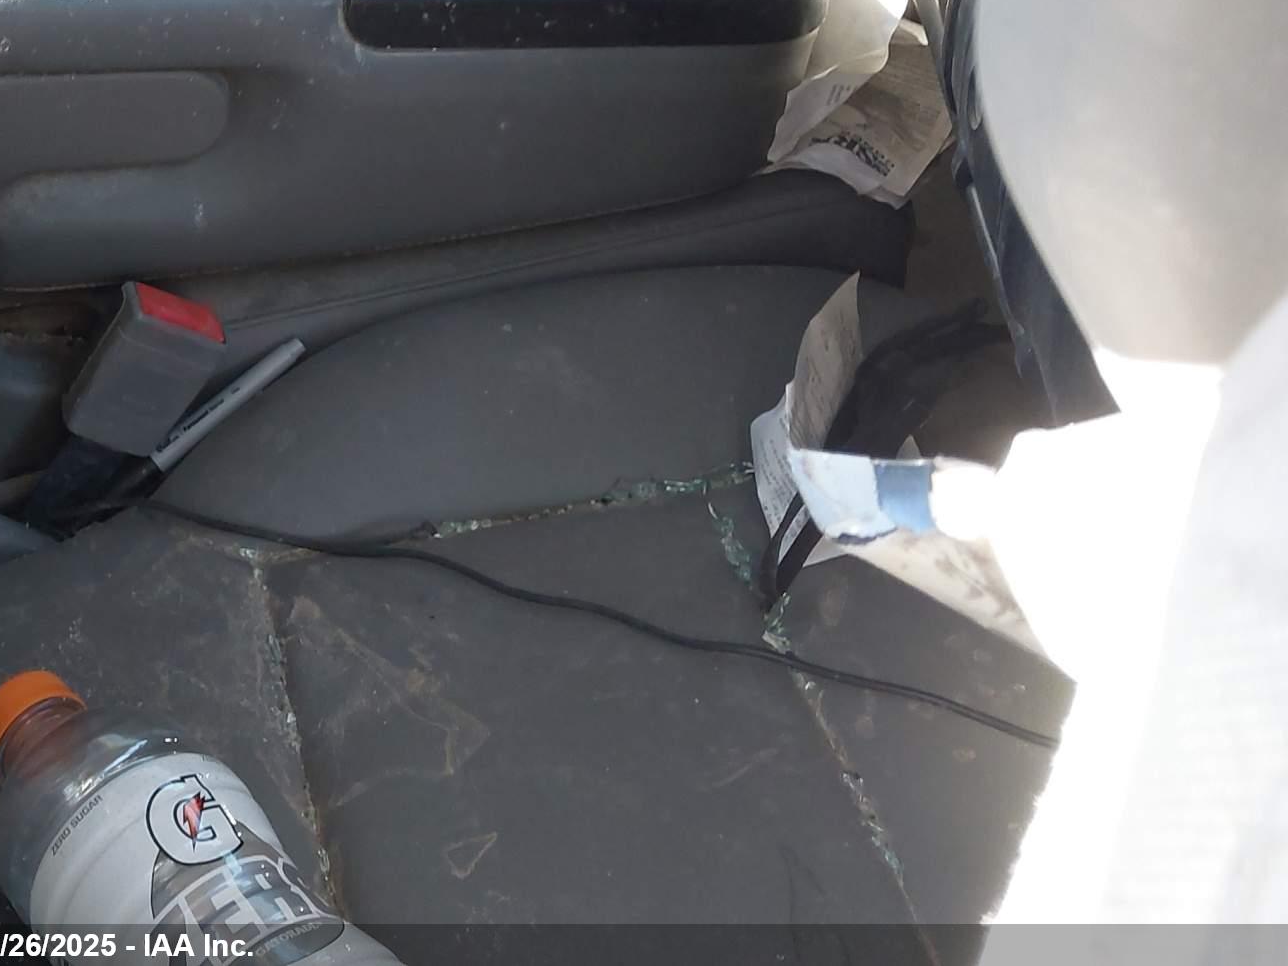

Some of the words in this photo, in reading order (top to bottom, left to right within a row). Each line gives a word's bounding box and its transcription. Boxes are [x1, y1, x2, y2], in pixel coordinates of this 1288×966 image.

[51, 827, 72, 857] ZERO
[70, 794, 103, 829] SUGAR
[146, 773, 245, 866] G
